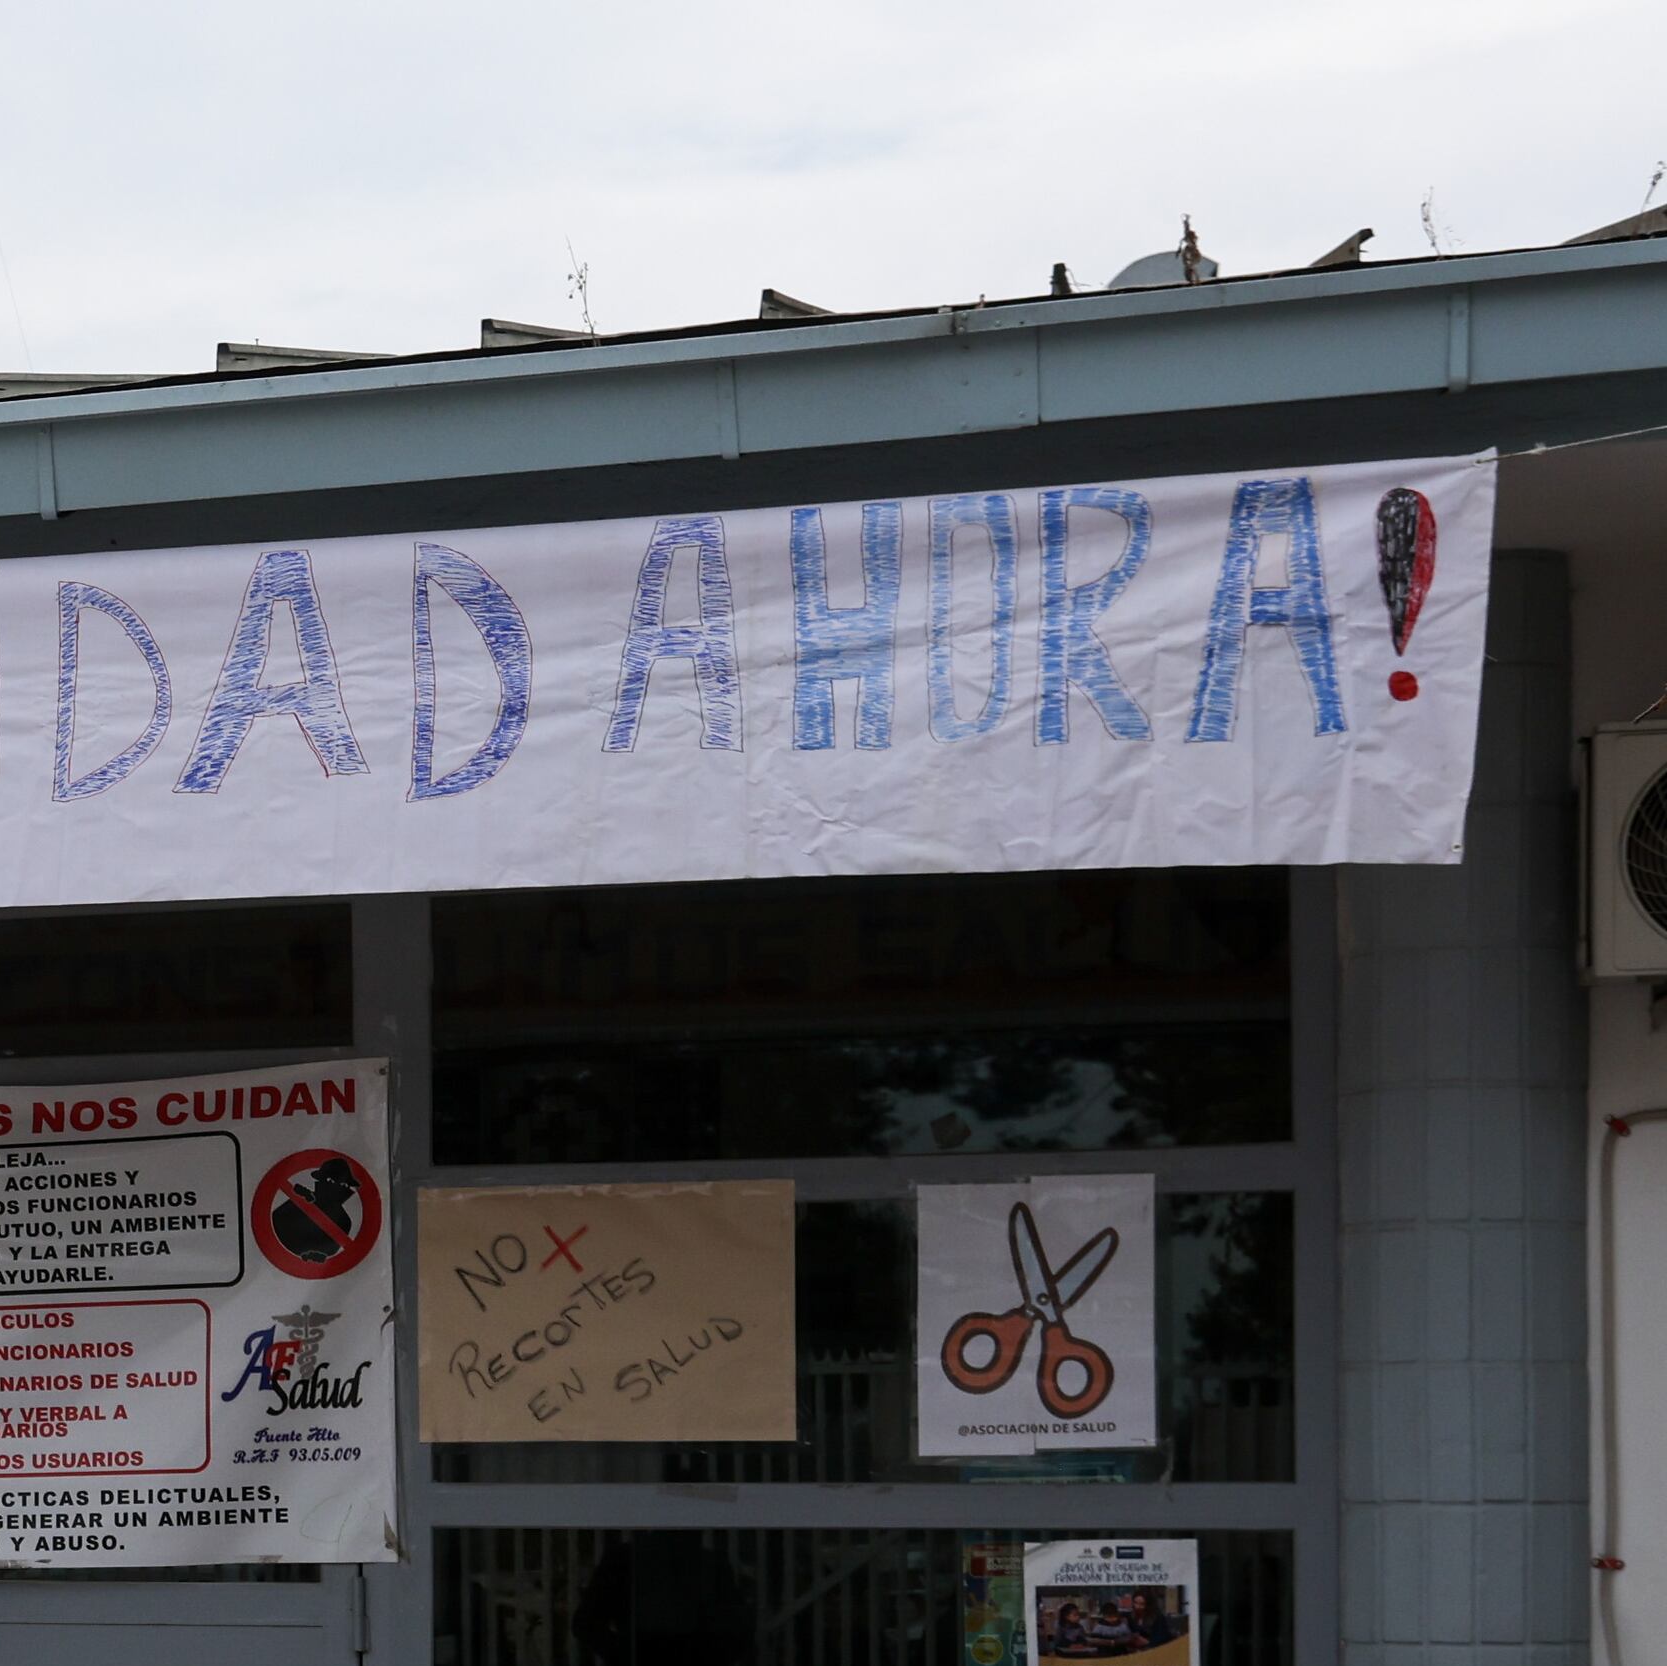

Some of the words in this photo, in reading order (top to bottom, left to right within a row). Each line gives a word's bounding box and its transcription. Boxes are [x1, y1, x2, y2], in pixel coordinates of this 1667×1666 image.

[601, 476, 1437, 753] AHORA!
[32, 1097, 139, 1135] NOS
[155, 1078, 356, 1127] CUIDAN
[4, 1171, 117, 1192] ACCIONES
[125, 1170, 140, 1186] Y
[27, 1190, 198, 1215] FUNCIONARIOS
[71, 1219, 103, 1236] UN
[110, 1213, 227, 1234] AMBIENTE
[10, 1244, 25, 1260] Y
[30, 1243, 58, 1260] LA
[66, 1240, 172, 1259] ENTREGA
[455, 1234, 528, 1313] NO
[90, 1372, 120, 1390] DE
[125, 1369, 199, 1389] SALUD
[527, 1367, 587, 1423] EN
[614, 1317, 744, 1402] SALUD
[267, 1360, 372, 1416] Salud
[0, 1406, 15, 1423] Y
[20, 1404, 107, 1423] VERBAL
[112, 1403, 128, 1420] A
[254, 1427, 302, 1443] Puente
[307, 1427, 340, 1441] Alto
[1052, 1422, 1070, 1434] DE
[1073, 1421, 1117, 1433] SALUD
[31, 1449, 145, 1470] USUARIOS
[289, 1446, 362, 1463] 93.05.009
[100, 1485, 281, 1506] DELICTUALES,
[113, 1511, 148, 1528] UN
[157, 1507, 290, 1528] AMBIENTE
[10, 1536, 26, 1552] Y
[34, 1534, 126, 1552] ABUSO.
